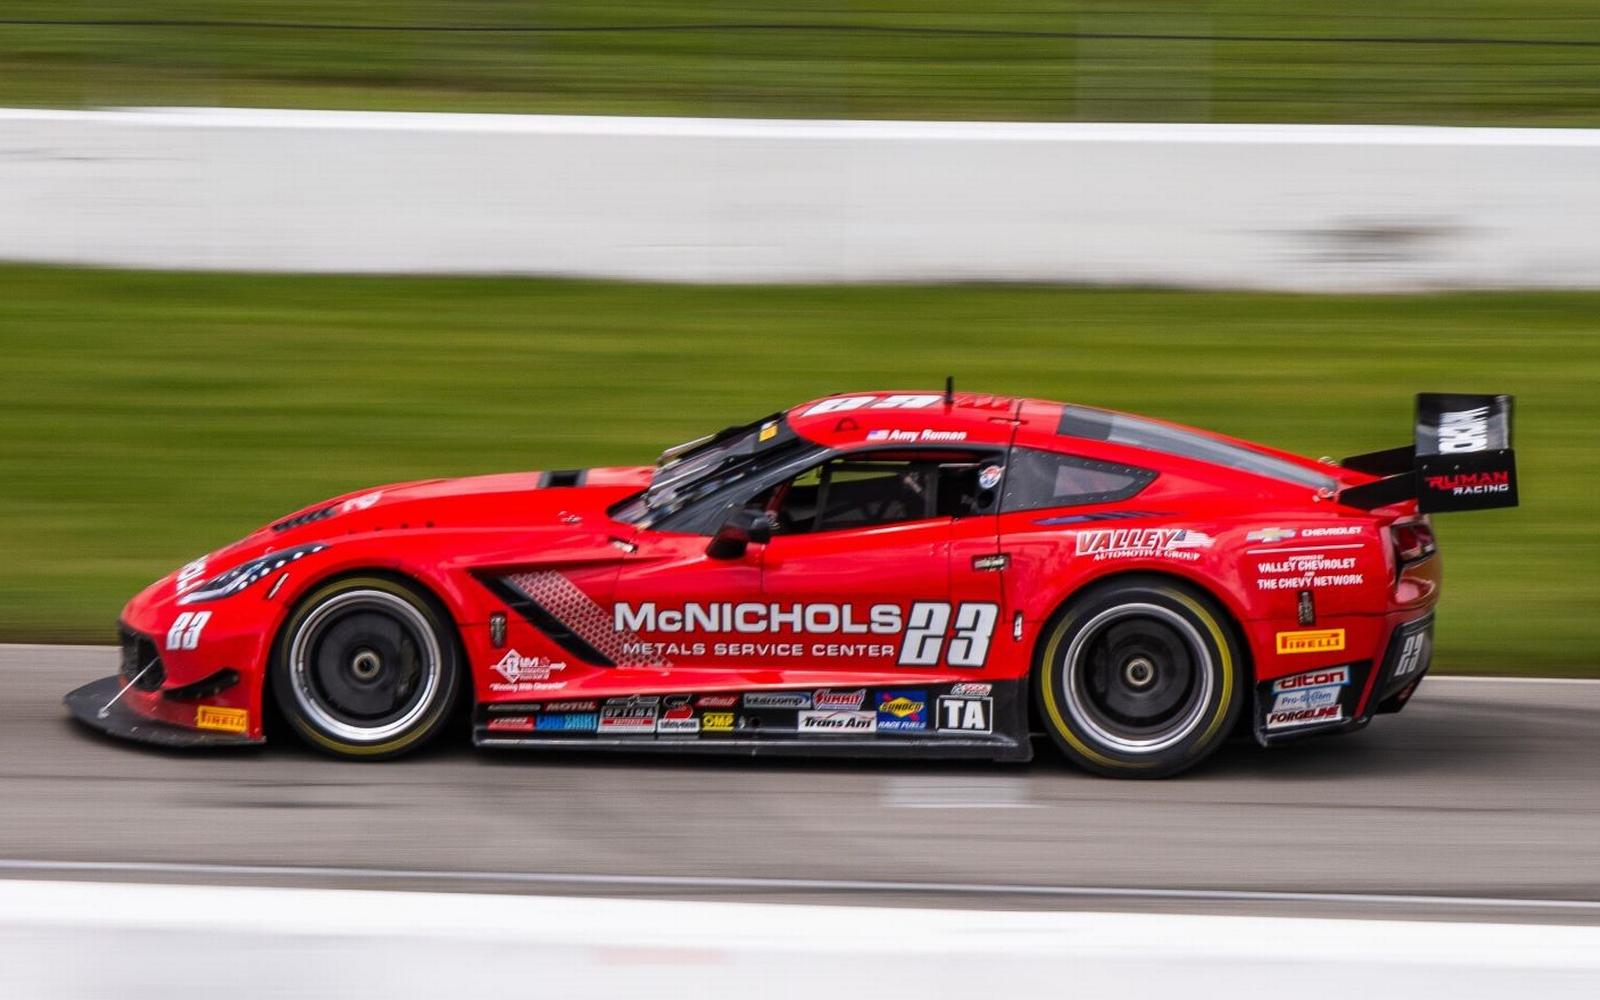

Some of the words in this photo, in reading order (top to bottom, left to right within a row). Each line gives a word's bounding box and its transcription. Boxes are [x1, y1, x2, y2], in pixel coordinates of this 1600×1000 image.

[889, 429, 918, 442] Amy
[1425, 471, 1509, 490] RUMAN
[1453, 483, 1509, 496] RACING
[1301, 526, 1363, 537] CHEVROLET
[1075, 528, 1181, 556] VALLEY
[1094, 548, 1161, 561] AUTOMOTIVE
[1258, 561, 1297, 573] VALLEY
[1298, 558, 1356, 571] CHEVROLET
[1257, 579, 1278, 590] THE
[1279, 575, 1313, 588] CHEVY
[1314, 574, 1363, 586] NETWORK
[614, 602, 903, 634] McNICHOLS
[897, 602, 1000, 667] 23
[1281, 633, 1340, 650] PIRELLI
[623, 642, 706, 656] METALS
[714, 643, 804, 657] SERVICE
[811, 643, 895, 657] CENTER
[546, 701, 597, 712] MOTUL
[605, 706, 654, 718] OPTIMA
[880, 702, 925, 712] SUNOCO
[704, 714, 734, 726] OMP
[943, 699, 986, 730] TA
[1269, 705, 1340, 724] FORGELINE
[804, 716, 844, 728] Trans
[845, 717, 872, 729] Am
[878, 721, 901, 729] RACE
[901, 721, 926, 729] FUELS
